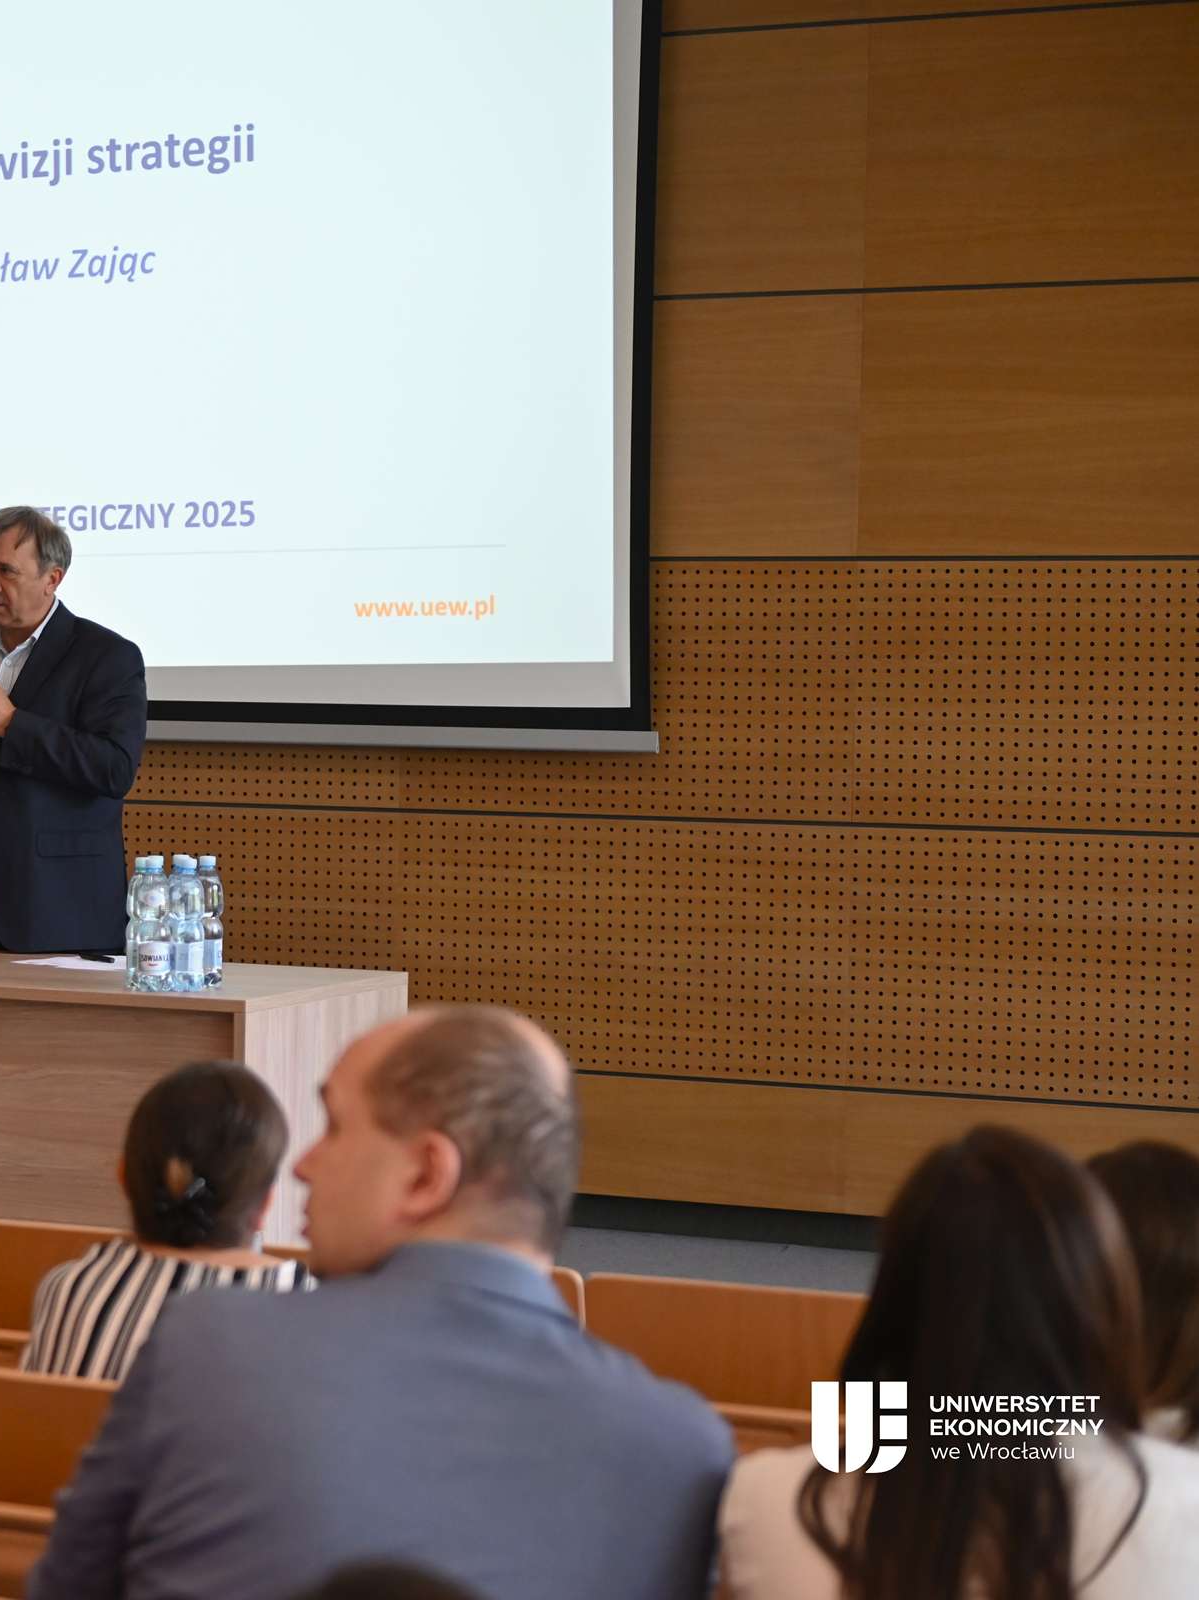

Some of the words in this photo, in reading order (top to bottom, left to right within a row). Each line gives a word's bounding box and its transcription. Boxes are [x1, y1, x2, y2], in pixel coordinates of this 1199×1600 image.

[86, 122, 256, 175] strategii
[67, 245, 157, 285] Zając
[184, 499, 256, 528] 2025
[353, 594, 496, 621] www.uew.pl
